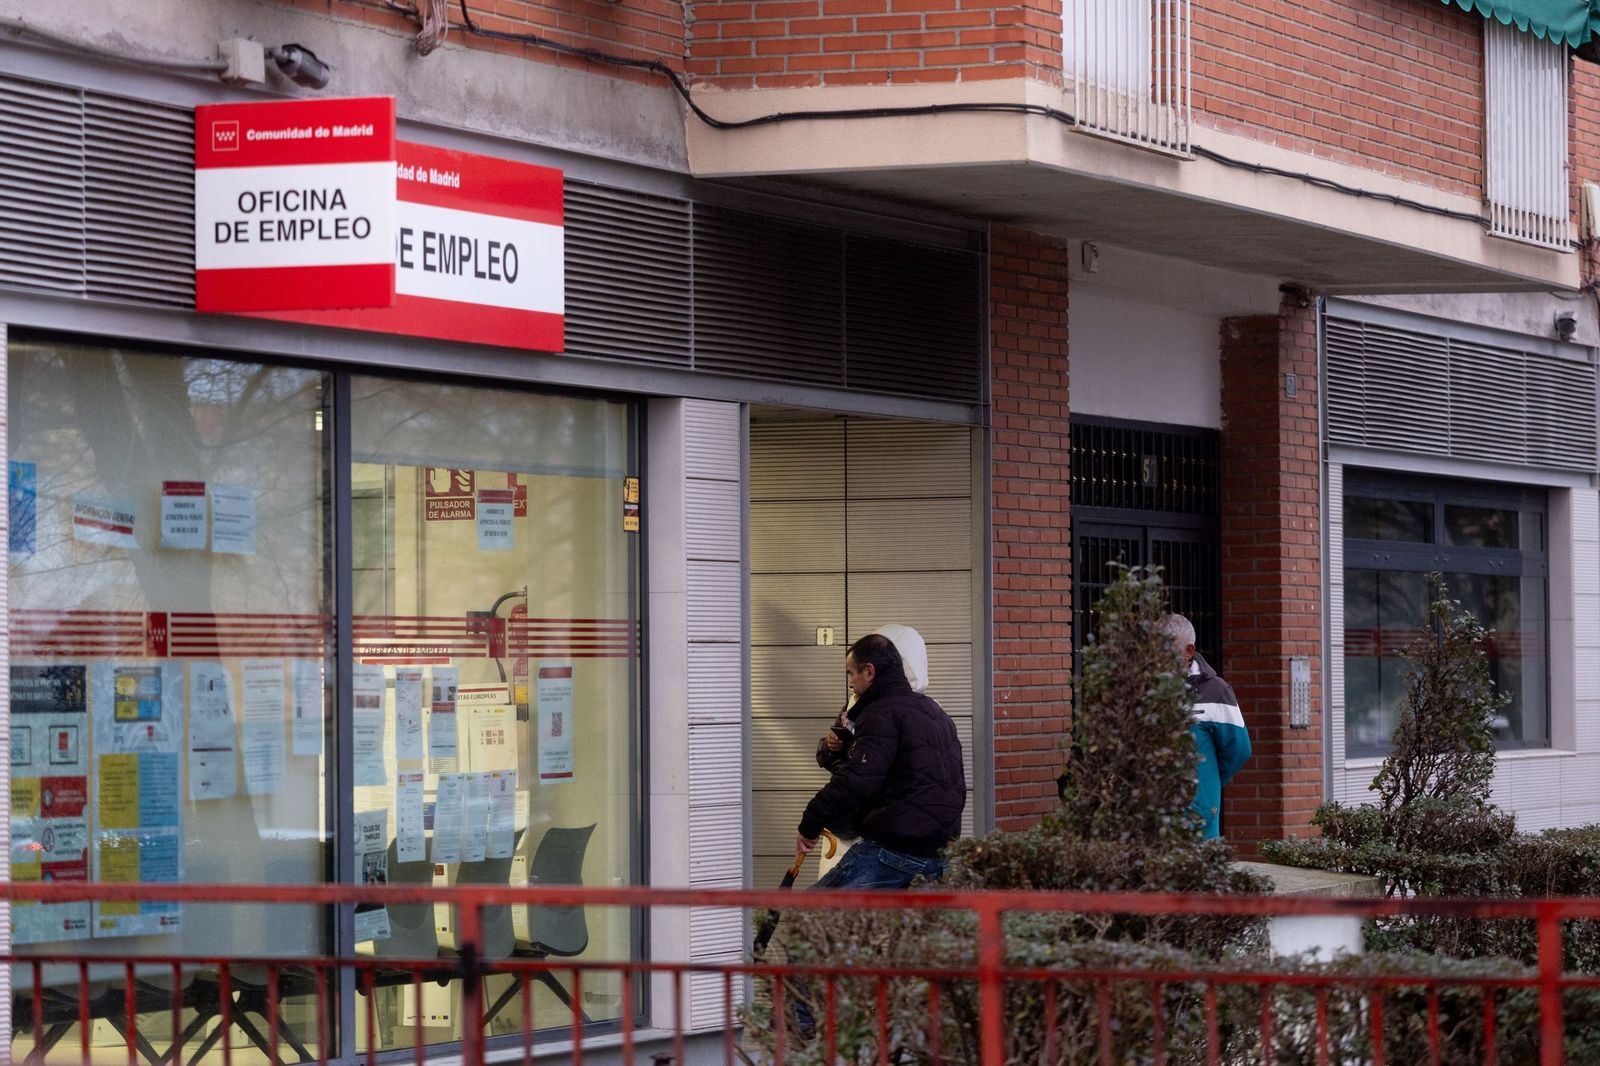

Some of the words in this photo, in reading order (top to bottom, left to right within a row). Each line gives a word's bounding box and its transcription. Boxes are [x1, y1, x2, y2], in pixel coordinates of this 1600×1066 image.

[246, 125, 313, 142] Comunidad
[315, 126, 330, 138] de
[332, 124, 375, 138] Madrid
[416, 166, 428, 183] de
[430, 168, 460, 188] Madrid
[238, 188, 347, 214] OFICINA
[214, 221, 250, 244] DE
[259, 216, 371, 243] EMPLEO
[396, 227, 414, 270] E
[422, 229, 519, 284] EMPLEO
[428, 511, 439, 519] DE
[440, 510, 472, 519] ALARMA
[429, 500, 471, 509] PULSADOR
